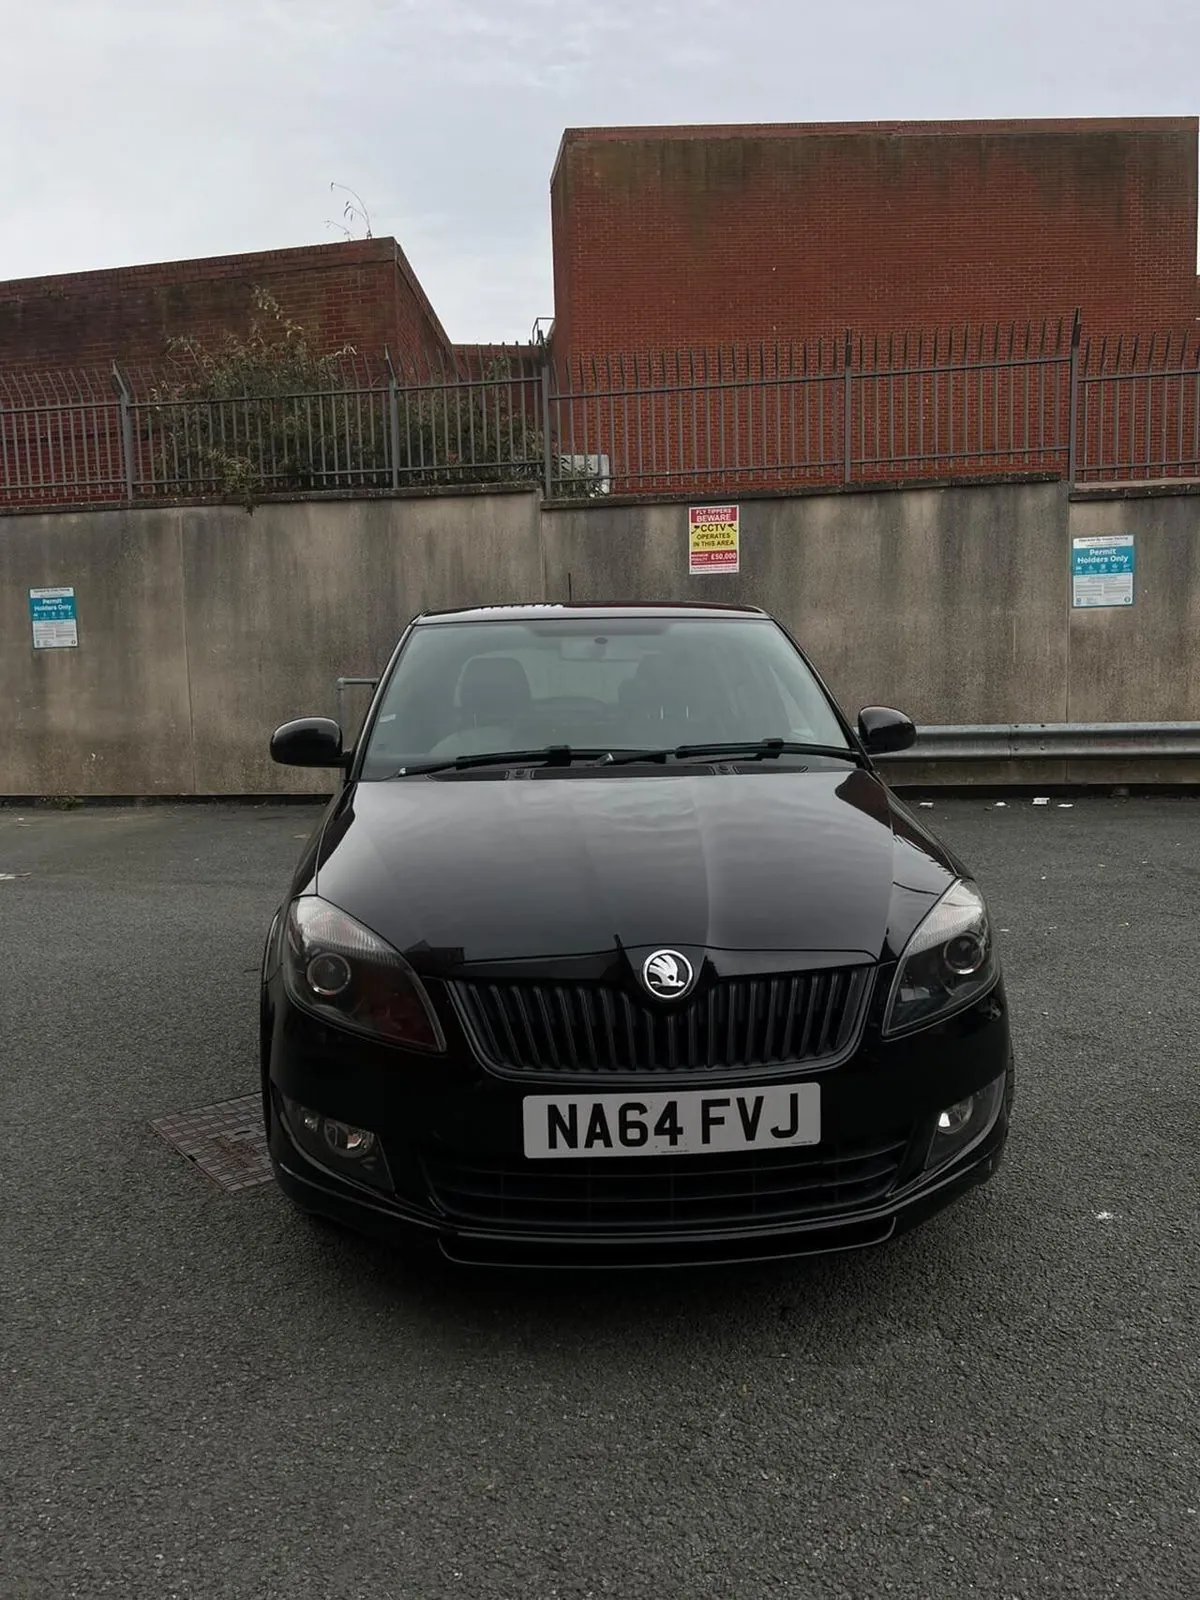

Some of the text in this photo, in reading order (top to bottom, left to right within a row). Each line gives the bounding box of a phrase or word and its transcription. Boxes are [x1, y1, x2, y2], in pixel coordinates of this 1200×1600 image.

[696, 514, 731, 522] BEWARE
[701, 524, 727, 532] CCTV
[1089, 548, 1117, 556] Permit
[1077, 555, 1129, 564] Holders Only
[57, 603, 72, 611] Only
[547, 1092, 799, 1150] NA64 FVJ
